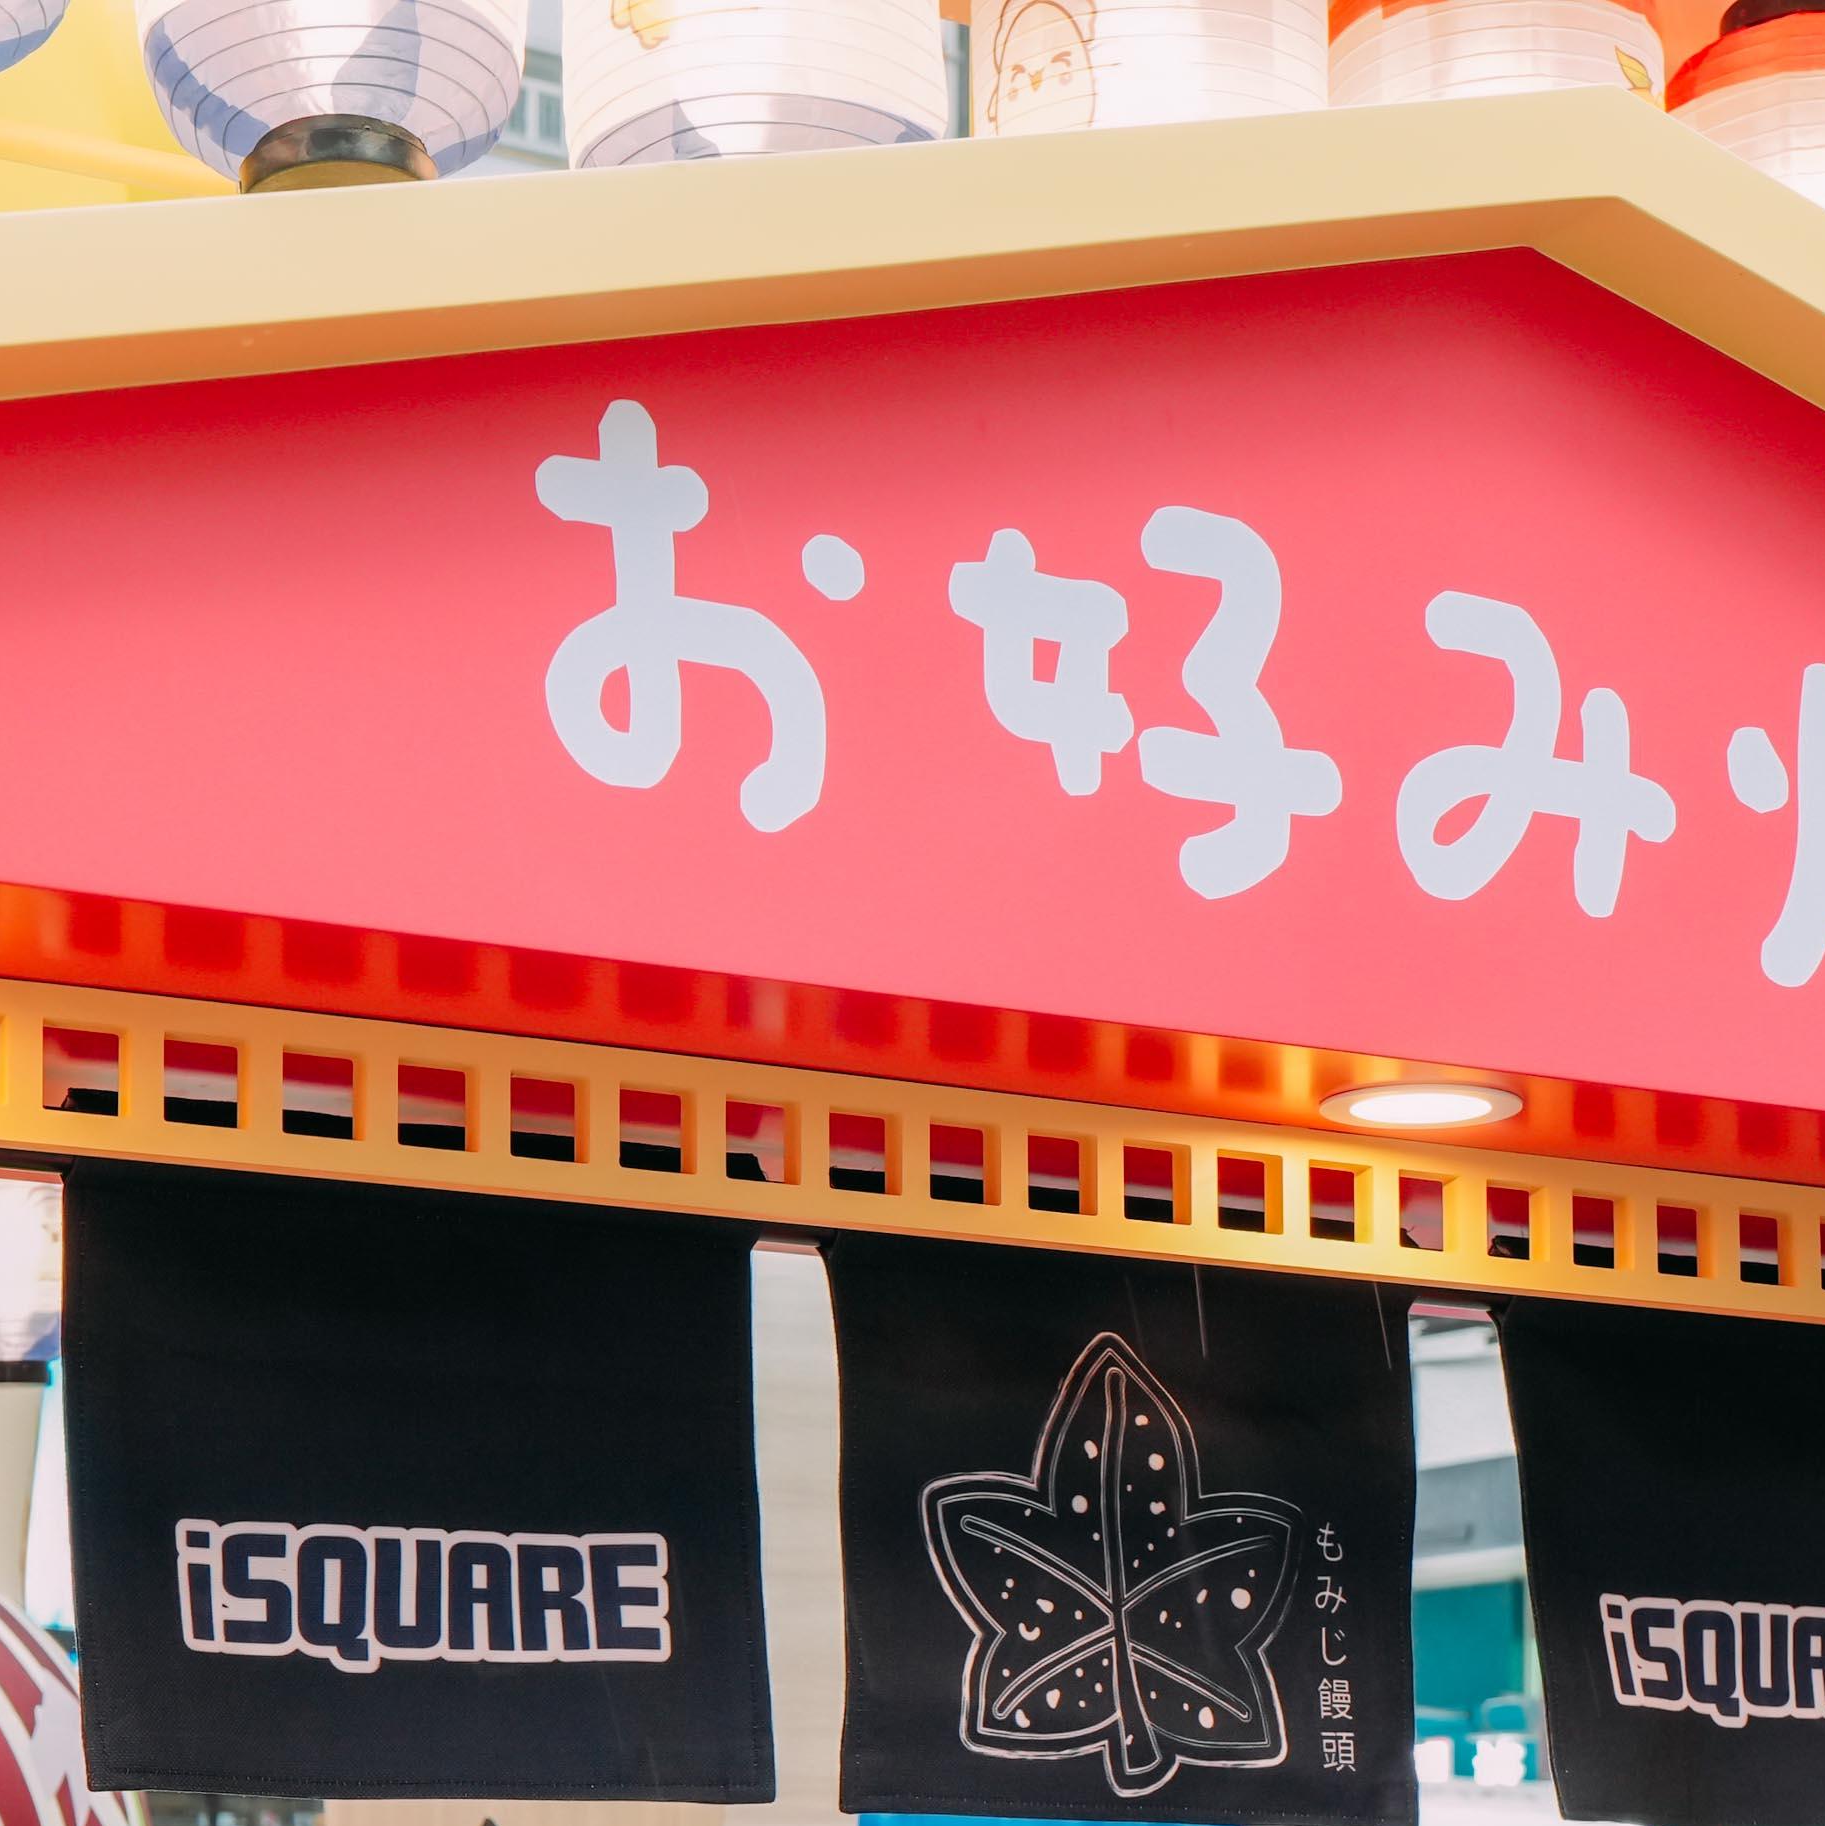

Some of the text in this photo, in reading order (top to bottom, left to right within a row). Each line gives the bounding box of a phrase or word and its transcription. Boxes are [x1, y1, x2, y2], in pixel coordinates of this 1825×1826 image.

[176, 1518, 671, 1673] iSQUARE
[1315, 1522, 1356, 1772] もみじ饅頭
